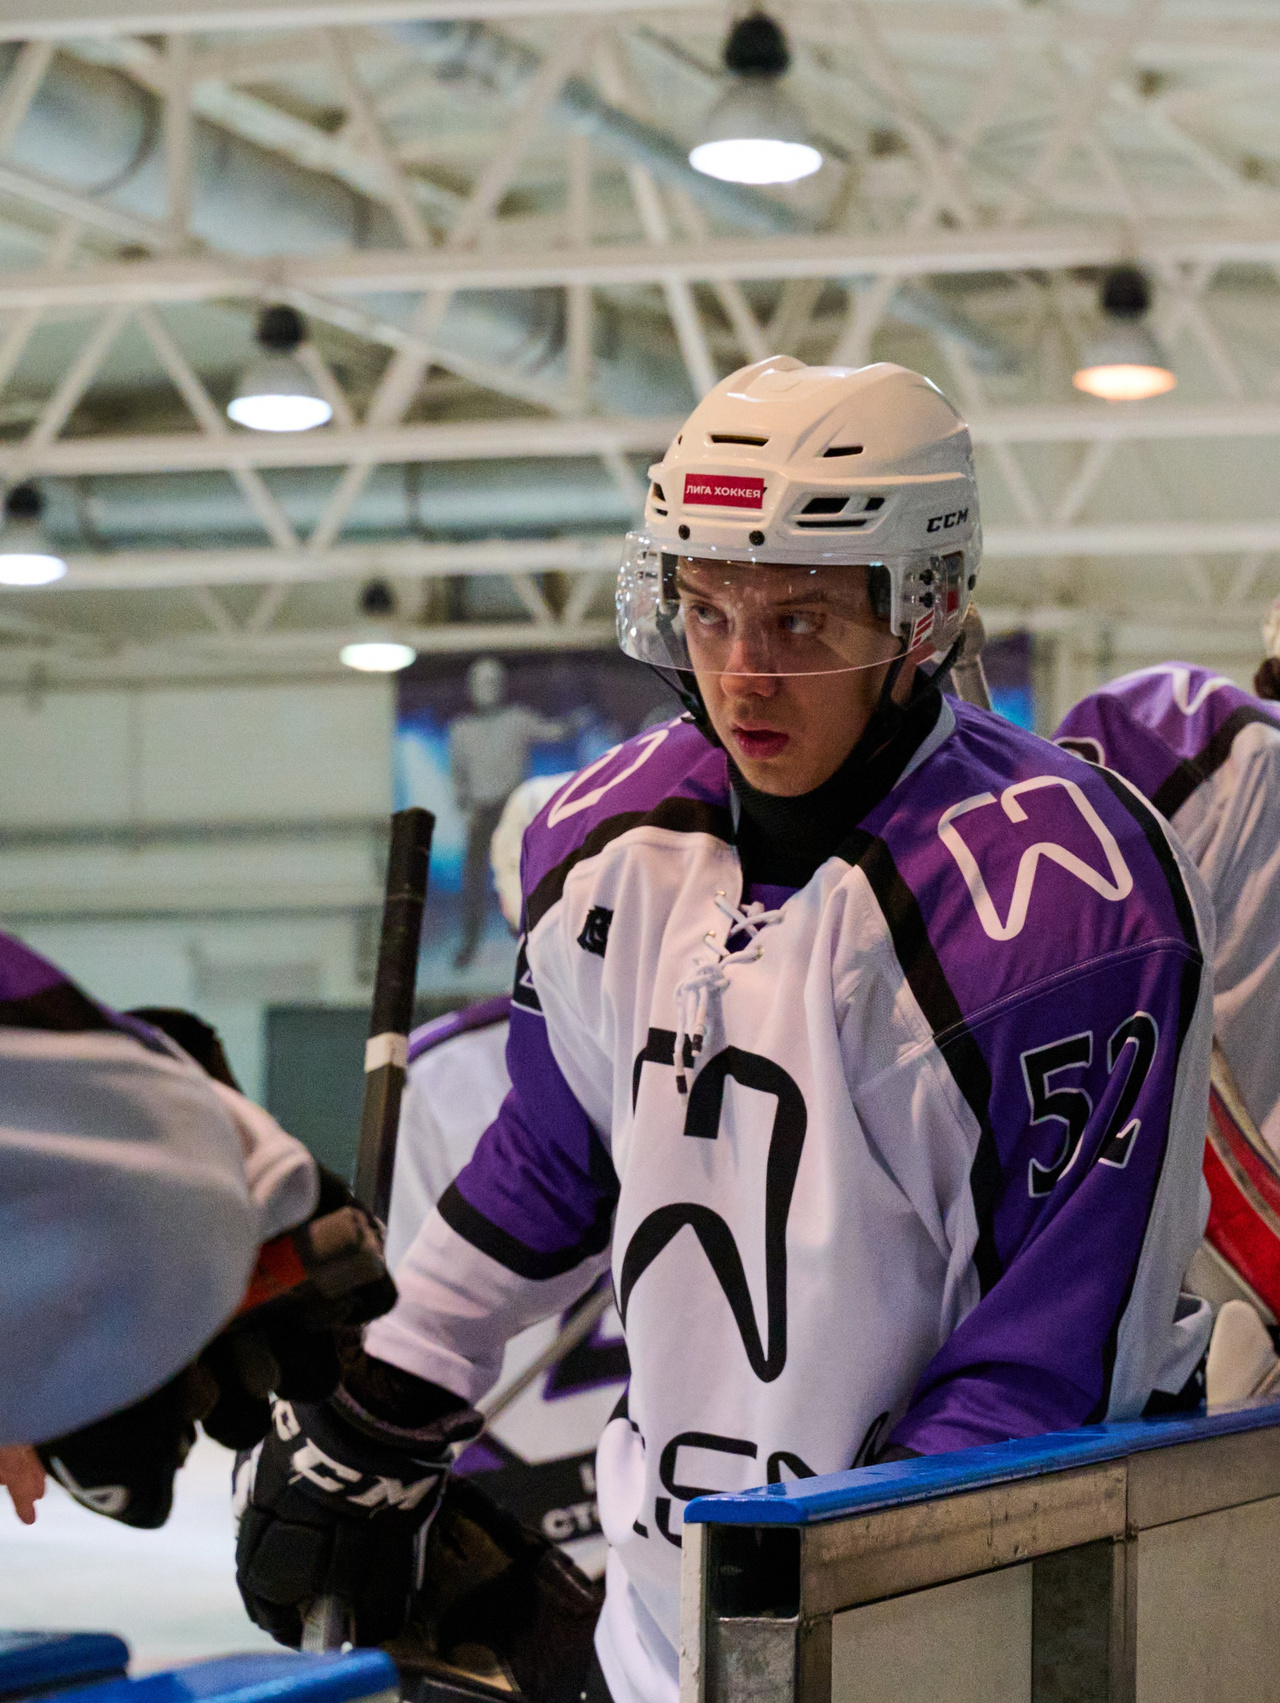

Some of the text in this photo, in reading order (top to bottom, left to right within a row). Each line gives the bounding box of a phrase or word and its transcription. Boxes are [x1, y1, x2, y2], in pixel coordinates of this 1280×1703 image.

[686, 485, 761, 498] ЛИГА ХОККЕЯ
[926, 507, 969, 533] CCM
[1020, 1010, 1159, 1198] 52
